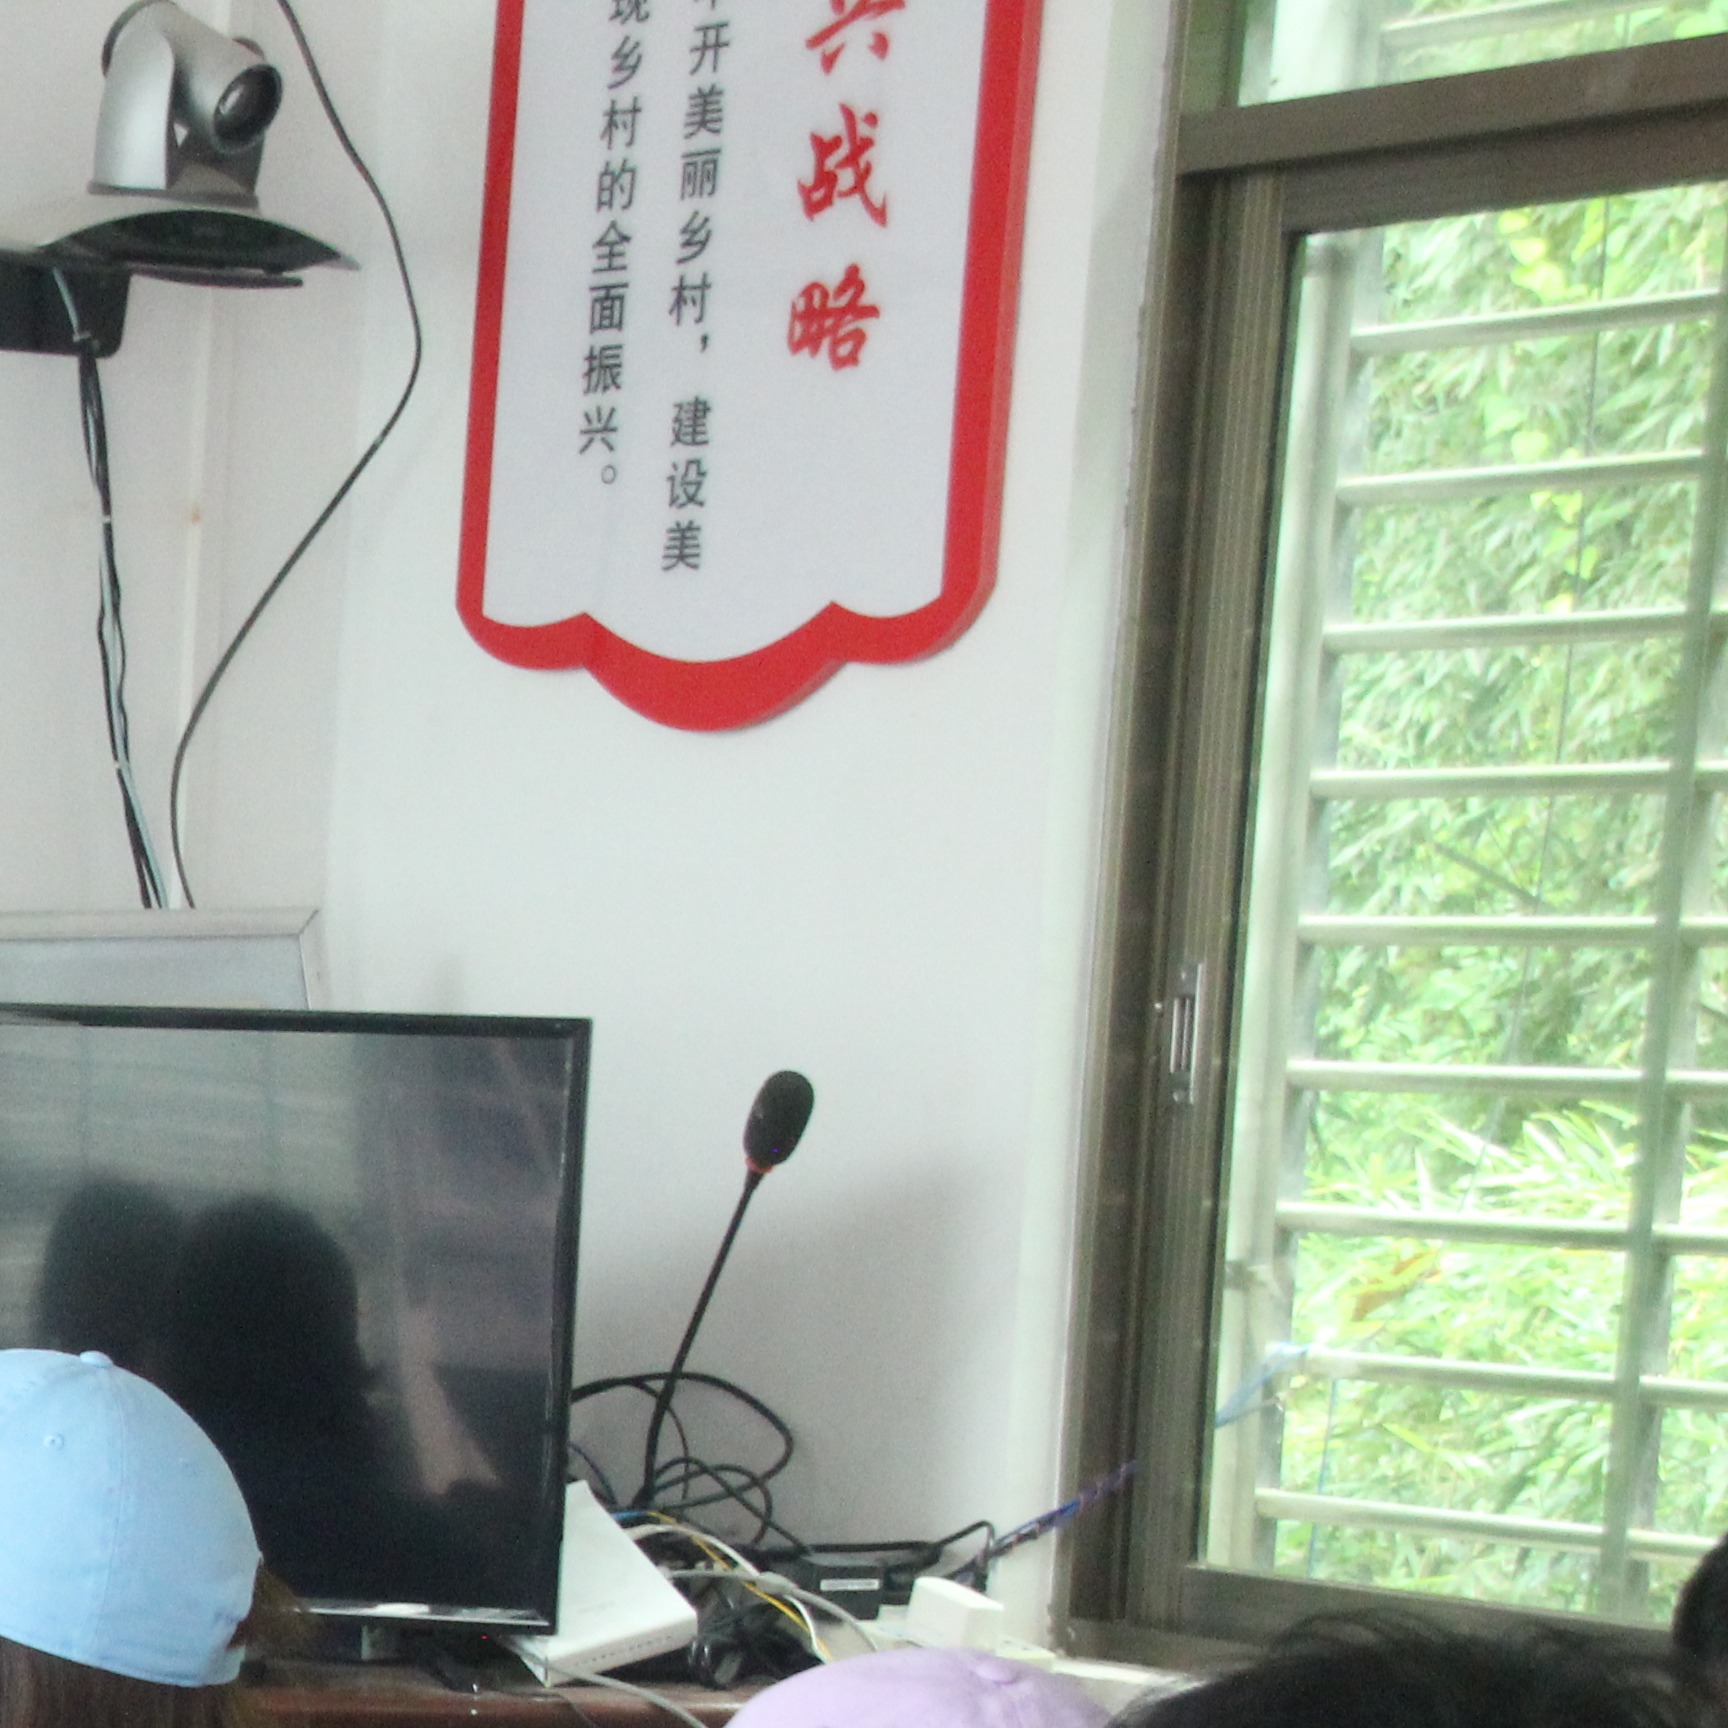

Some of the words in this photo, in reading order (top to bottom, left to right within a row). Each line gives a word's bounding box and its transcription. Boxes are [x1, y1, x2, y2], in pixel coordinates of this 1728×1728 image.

[661, 0, 732, 572] 开美丽乡村，建设美
